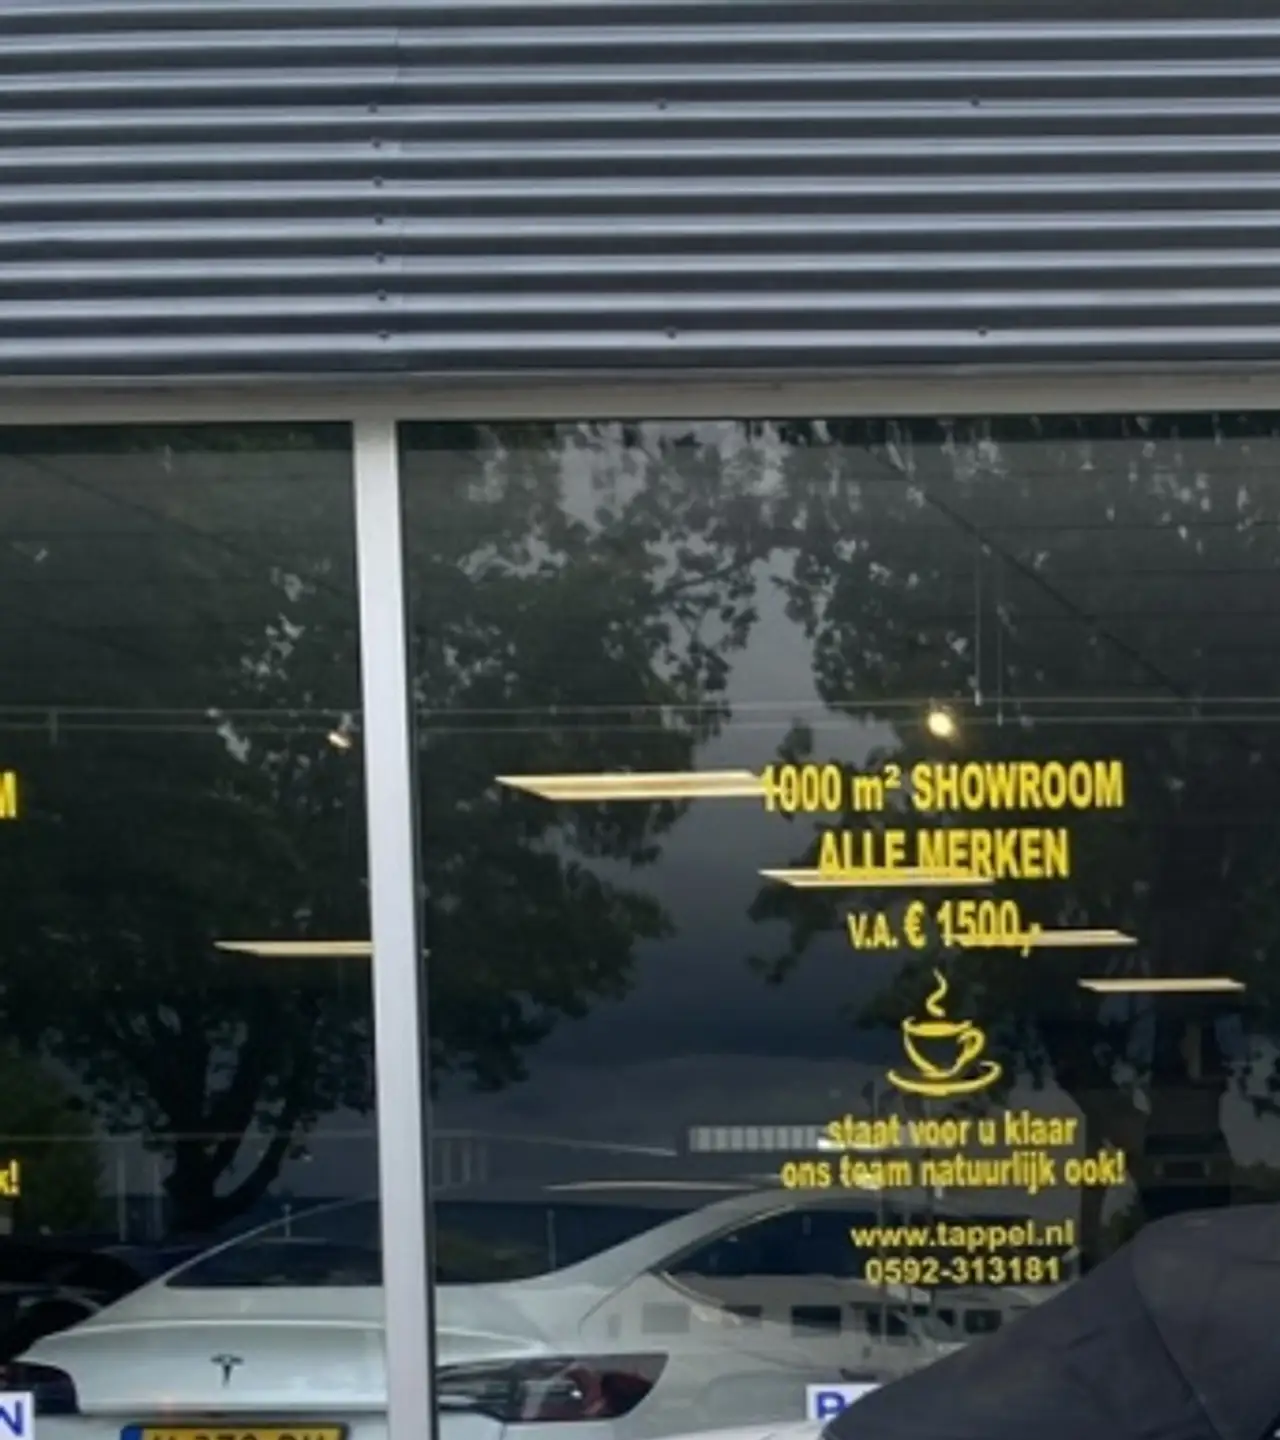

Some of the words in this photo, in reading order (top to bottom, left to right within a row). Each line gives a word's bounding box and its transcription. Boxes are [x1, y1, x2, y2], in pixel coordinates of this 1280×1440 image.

[763, 764, 843, 812] 1000
[910, 760, 1125, 812] SHOWROOM
[818, 830, 906, 878] ALLE
[917, 828, 1070, 878] MERKEN
[847, 912, 898, 949] V.A.
[903, 900, 927, 949] €
[827, 1114, 901, 1148] staat
[908, 1119, 969, 1147] voor
[978, 1120, 997, 1146] u
[1004, 1111, 1078, 1146] klaar
[781, 1160, 831, 1188] ons
[839, 1155, 912, 1189] team
[920, 1150, 1056, 1193] natuurlijk
[1063, 1151, 1126, 1185] ook!
[850, 1220, 1075, 1251] www.tappel.nl
[865, 1257, 1061, 1285] 0592-313181
